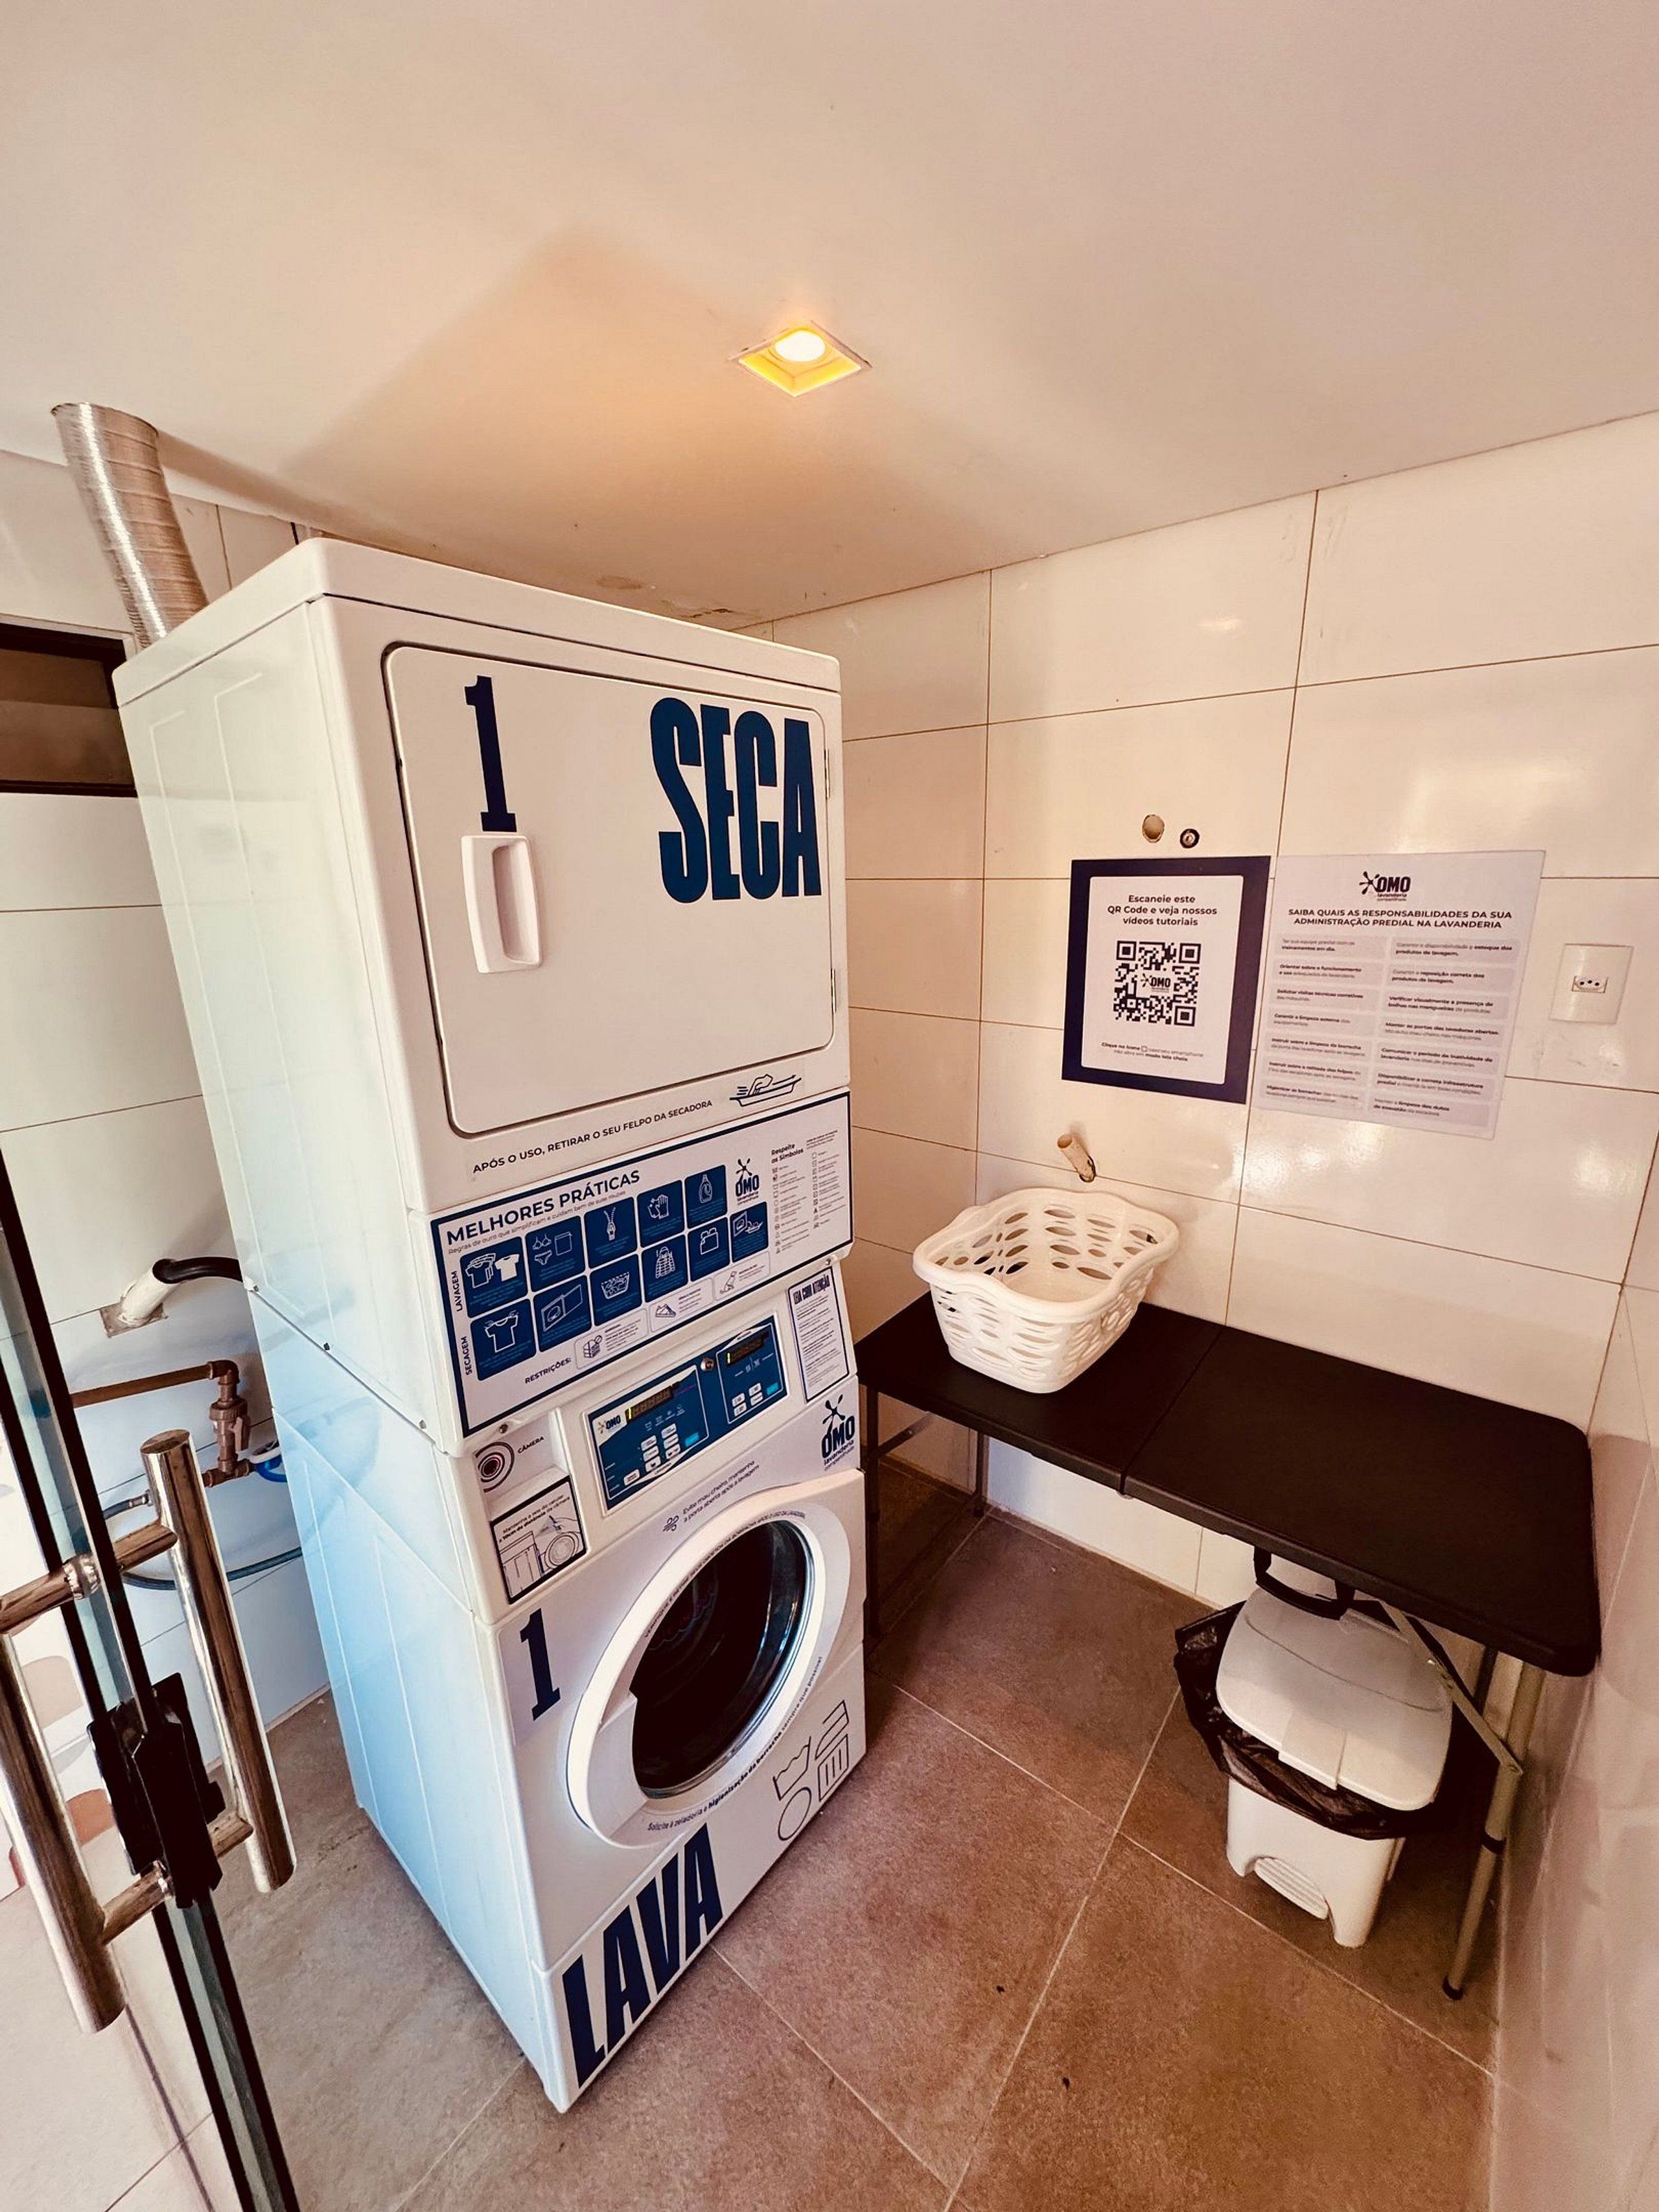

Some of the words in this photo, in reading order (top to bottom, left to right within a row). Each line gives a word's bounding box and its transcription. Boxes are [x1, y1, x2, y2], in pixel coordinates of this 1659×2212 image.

[464, 675, 517, 833] 1
[649, 697, 822, 903] SECA
[1128, 894, 1172, 903] Escaneie
[1376, 876, 1411, 893] OMO
[1108, 905, 1121, 915] QR
[1123, 905, 1148, 914] Code
[1159, 906, 1179, 916] veja
[1122, 916, 1154, 925] vídeos
[1156, 917, 1198, 926] tutoriais
[1294, 918, 1370, 927] ADMINISTRAÇÃO
[1434, 920, 1502, 928] LAVANDERIA
[1362, 909, 1469, 918] RESPONSABILIDADES
[1150, 977, 1171, 988] OMO
[473, 1158, 505, 1173] APÓS
[507, 1155, 516, 1163] O
[520, 1148, 545, 1160] USO,
[548, 1134, 590, 1152] RETIRAR
[603, 1125, 620, 1137] SEU
[623, 1117, 652, 1130] FELPO
[654, 1113, 666, 1123] DA
[668, 1100, 712, 1118] SECADORA
[735, 1174, 760, 1197] OMO
[447, 1199, 555, 1245] MELHORES
[559, 1170, 640, 1207] PRÁTICAS
[448, 1243, 471, 1254] Regras
[511, 1218, 546, 1232] simplificam
[451, 1271, 463, 1312] LAVAGEM
[460, 1335, 473, 1375] SECAGEM
[518, 1436, 544, 1454] CÂMERA
[821, 1415, 855, 1459] OMO
[520, 1608, 561, 1721] 1
[562, 1822, 724, 2089] LAVA
